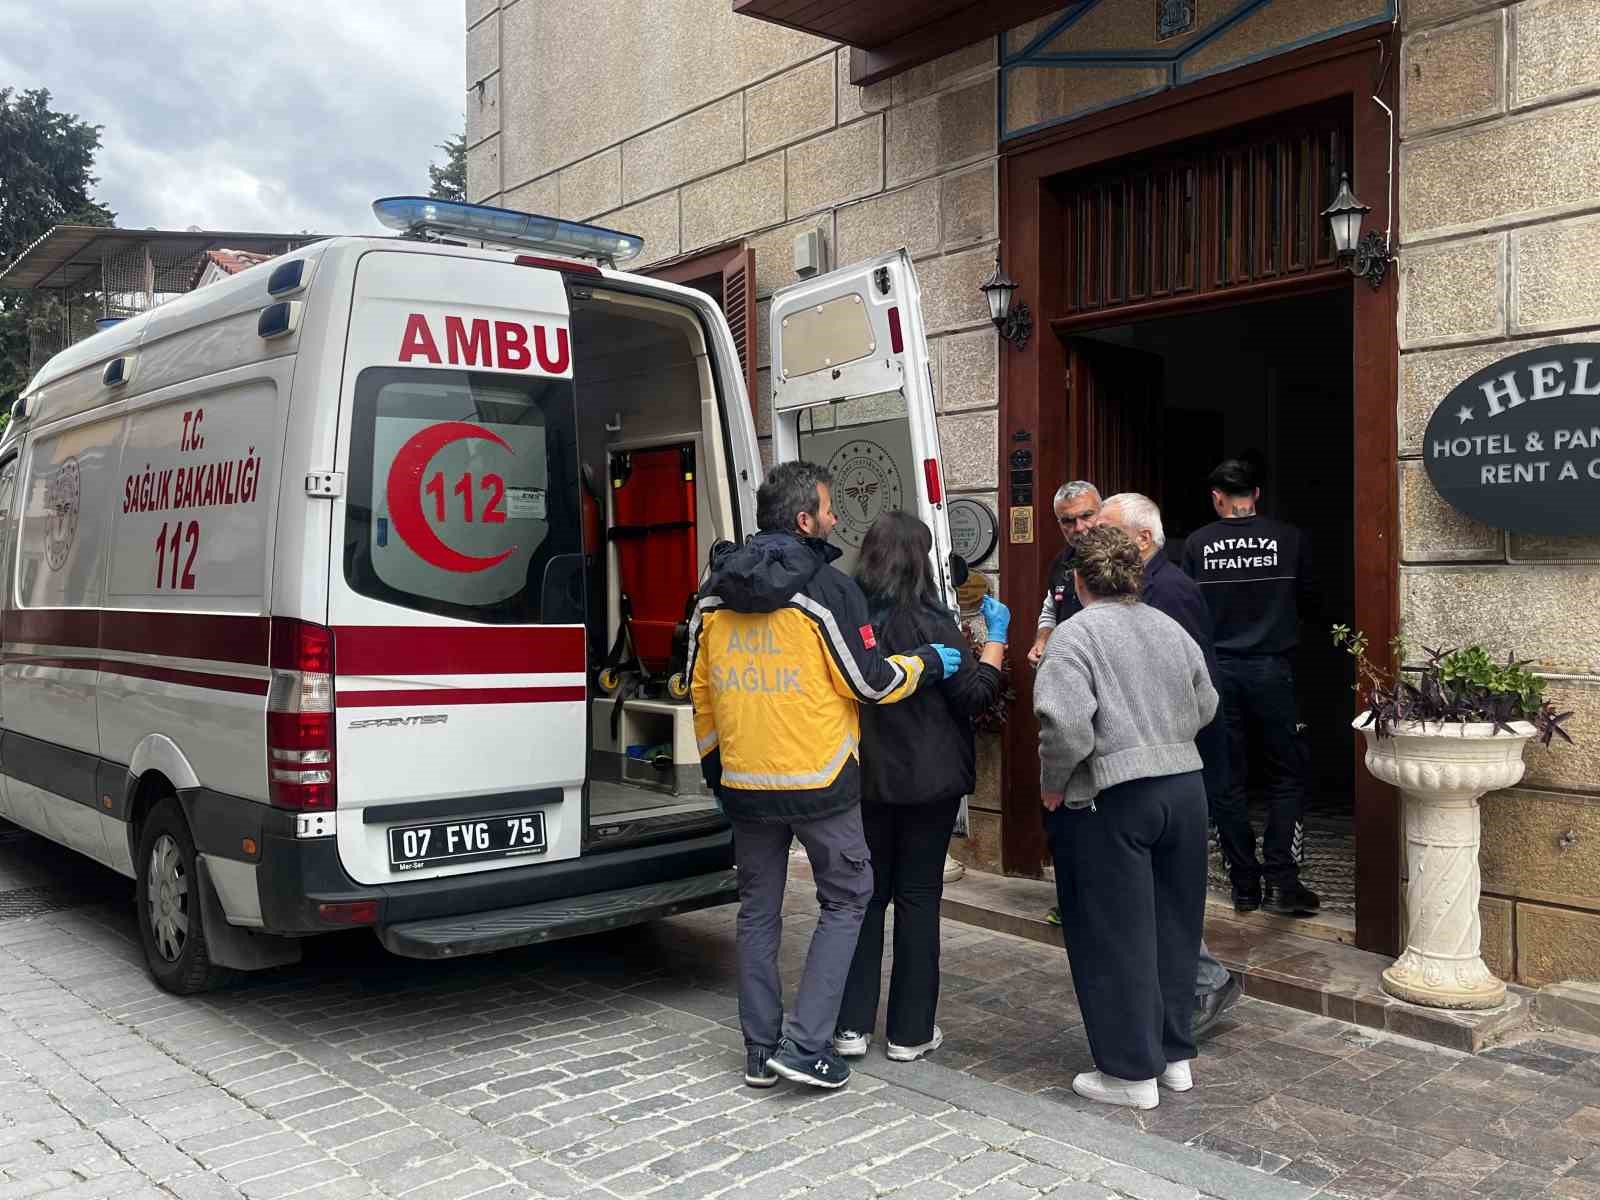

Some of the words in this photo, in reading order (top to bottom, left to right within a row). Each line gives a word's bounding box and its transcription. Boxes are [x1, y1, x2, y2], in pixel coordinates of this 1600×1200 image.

[398, 313, 570, 374] AMBU
[180, 408, 205, 452] T.C.
[1433, 434, 1517, 458] HOTEL
[1525, 431, 1544, 452] &
[123, 463, 173, 514] SAĞLIK
[174, 447, 262, 509] BAKANLIĞI
[1481, 462, 1550, 484] RENT
[1558, 460, 1579, 480] A
[426, 472, 506, 524] 112
[155, 520, 200, 590] 112
[1203, 537, 1278, 557] ANTALYA
[1203, 553, 1278, 570] İTFAİYESİ
[711, 657, 801, 693] SAĞLIK
[348, 714, 449, 730] SPRINTER
[403, 828, 431, 858] 07
[446, 823, 490, 853] FVG
[507, 817, 535, 845] 75
